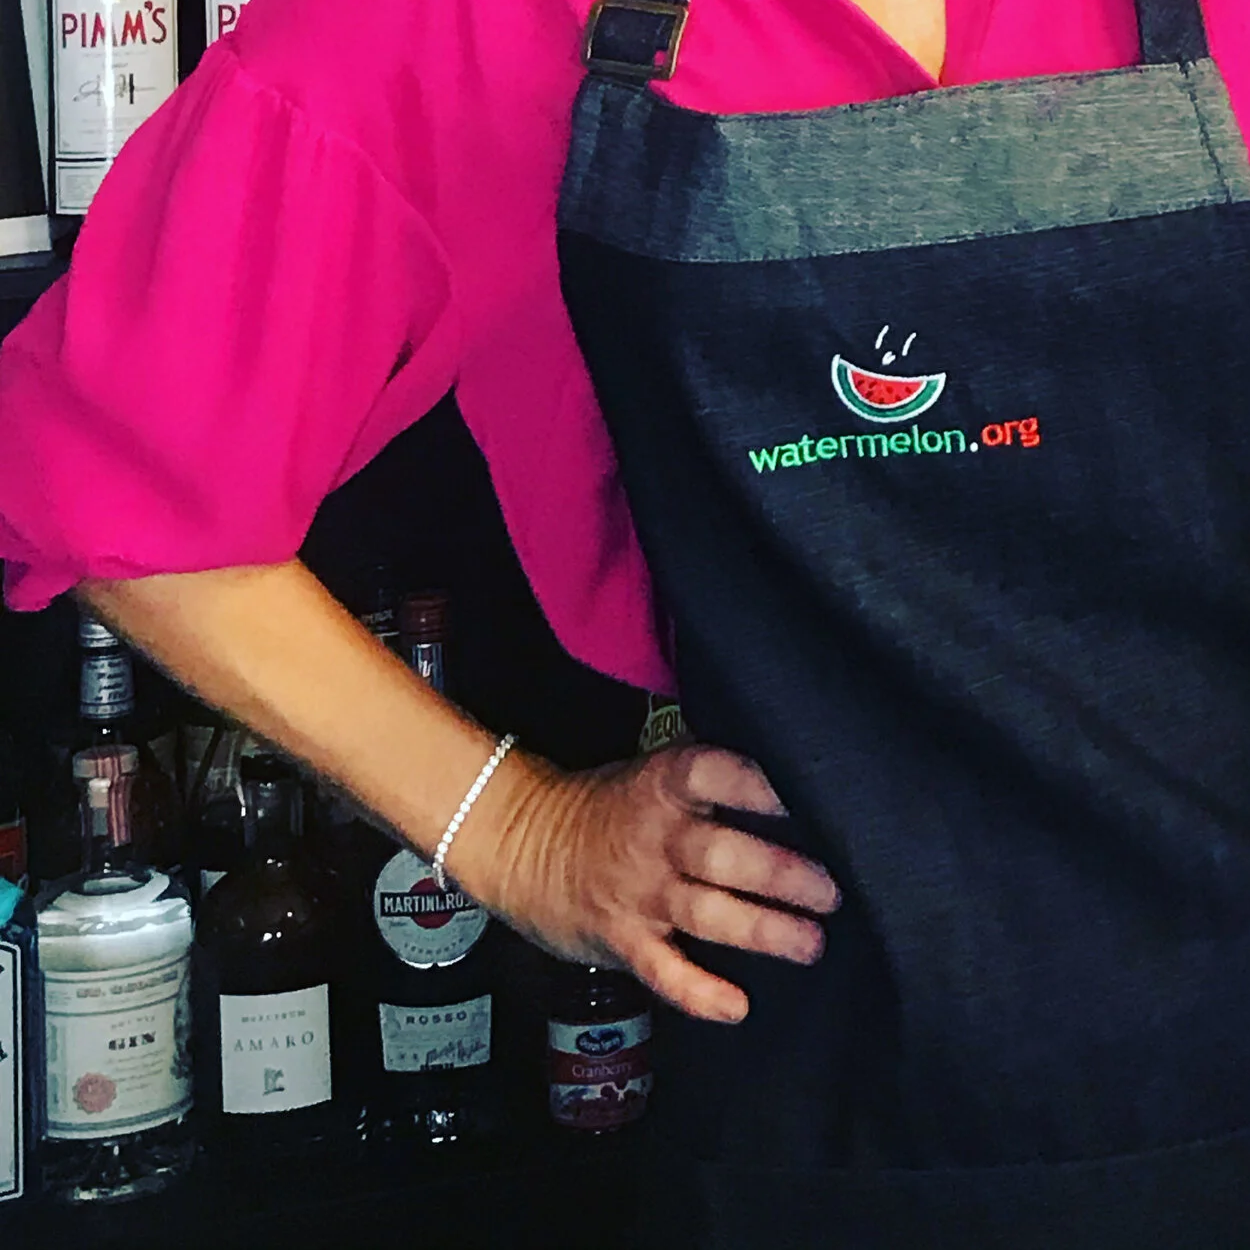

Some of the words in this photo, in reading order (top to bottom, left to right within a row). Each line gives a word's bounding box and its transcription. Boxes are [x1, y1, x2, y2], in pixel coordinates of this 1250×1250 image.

[62, 0, 168, 49] PIMM'S
[749, 416, 1041, 474] watermelon.org
[406, 1010, 467, 1026] ROSSO
[108, 1032, 156, 1051] GIN
[233, 1030, 315, 1052] AMARO
